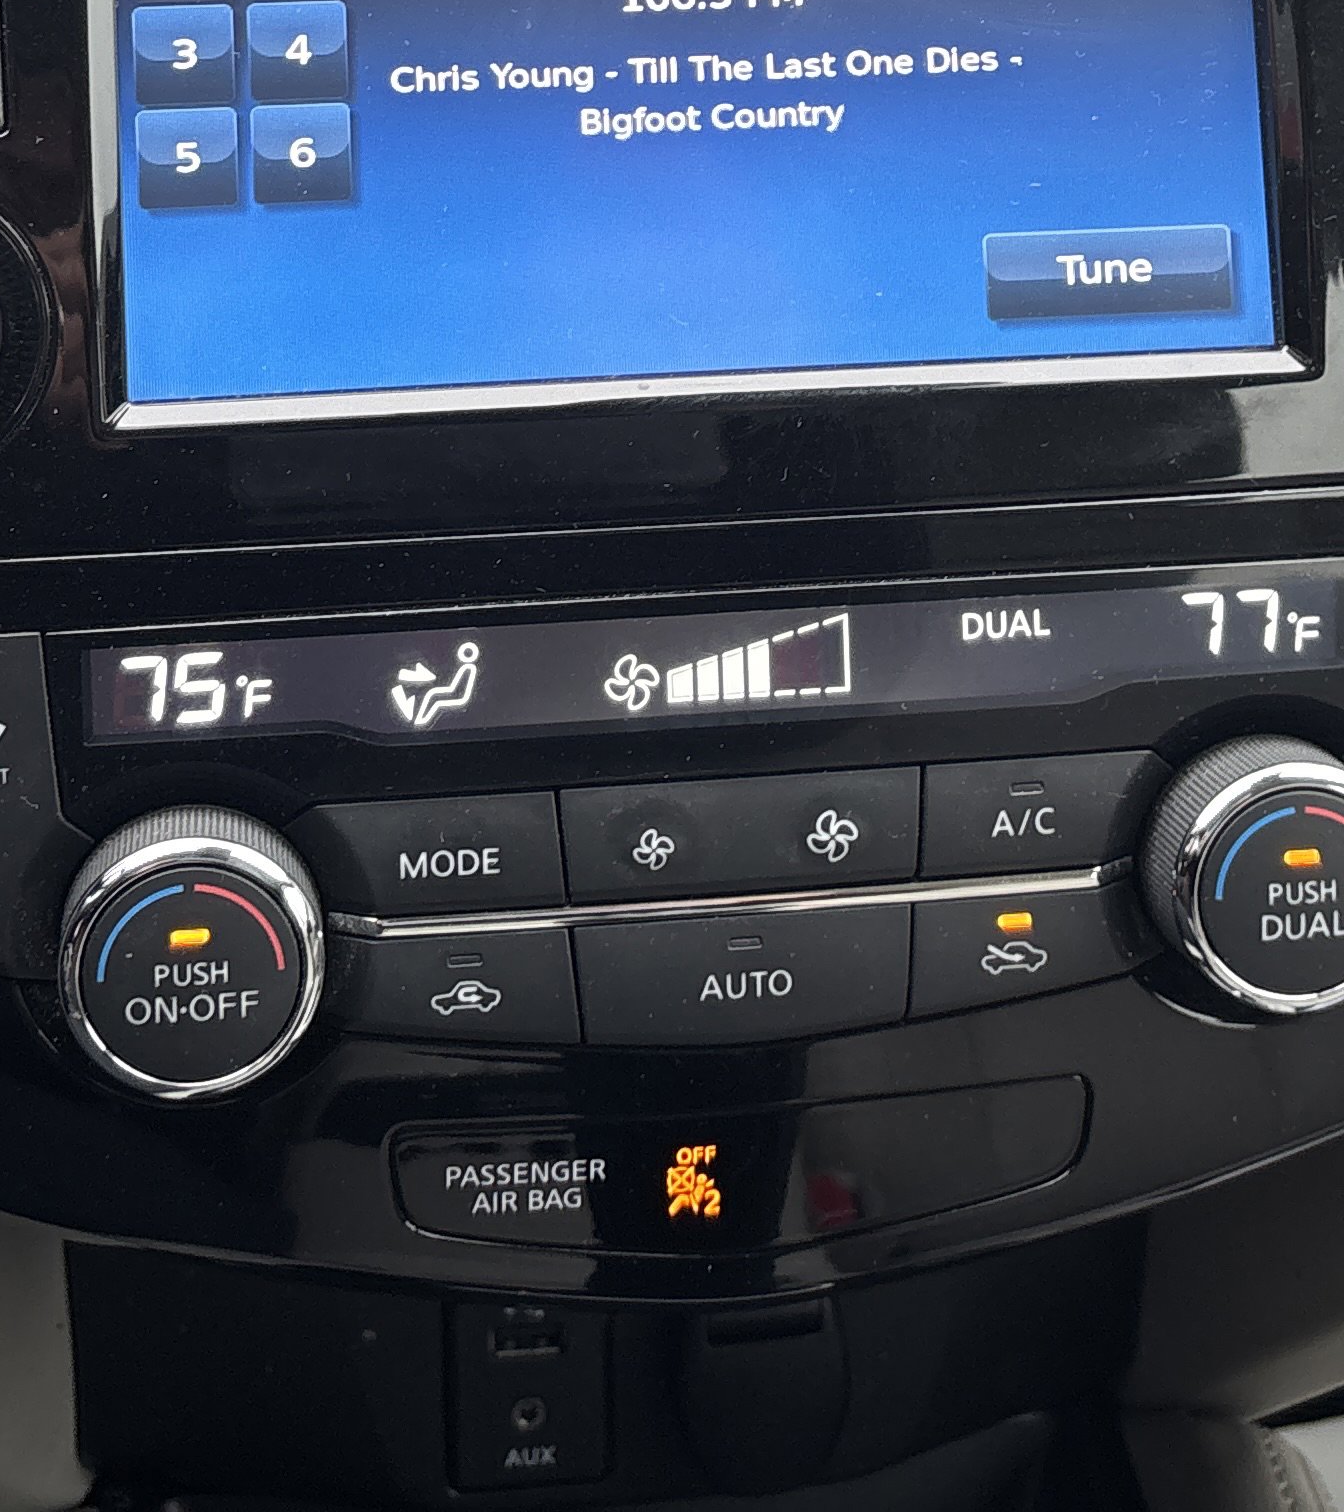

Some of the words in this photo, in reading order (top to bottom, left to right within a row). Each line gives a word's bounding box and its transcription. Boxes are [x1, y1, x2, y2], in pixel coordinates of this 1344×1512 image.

[172, 38, 197, 69] 3
[285, 34, 312, 66] 4
[390, 64, 479, 95] Chris
[490, 61, 594, 94] Young
[628, 55, 678, 85] Till
[688, 53, 754, 84] The
[765, 51, 836, 80] Last
[845, 49, 914, 78] One
[926, 46, 998, 74] Dies
[581, 105, 701, 141] Bigfoot
[711, 101, 844, 133] Country
[175, 141, 200, 173] 5
[289, 137, 316, 169] 6
[1056, 254, 1153, 286] Tune
[961, 608, 1051, 642] DUAL
[991, 807, 1056, 837] A/C
[399, 847, 501, 880] MODE
[1268, 879, 1338, 905] PUSH
[154, 961, 229, 988] PUSH
[700, 969, 793, 1002] AUTO
[675, 1144, 717, 1165] OFF
[445, 1157, 607, 1189] PASSENGER
[472, 1190, 518, 1215] AIR
[527, 1187, 582, 1212] BAG
[504, 1444, 557, 1469] AUX
